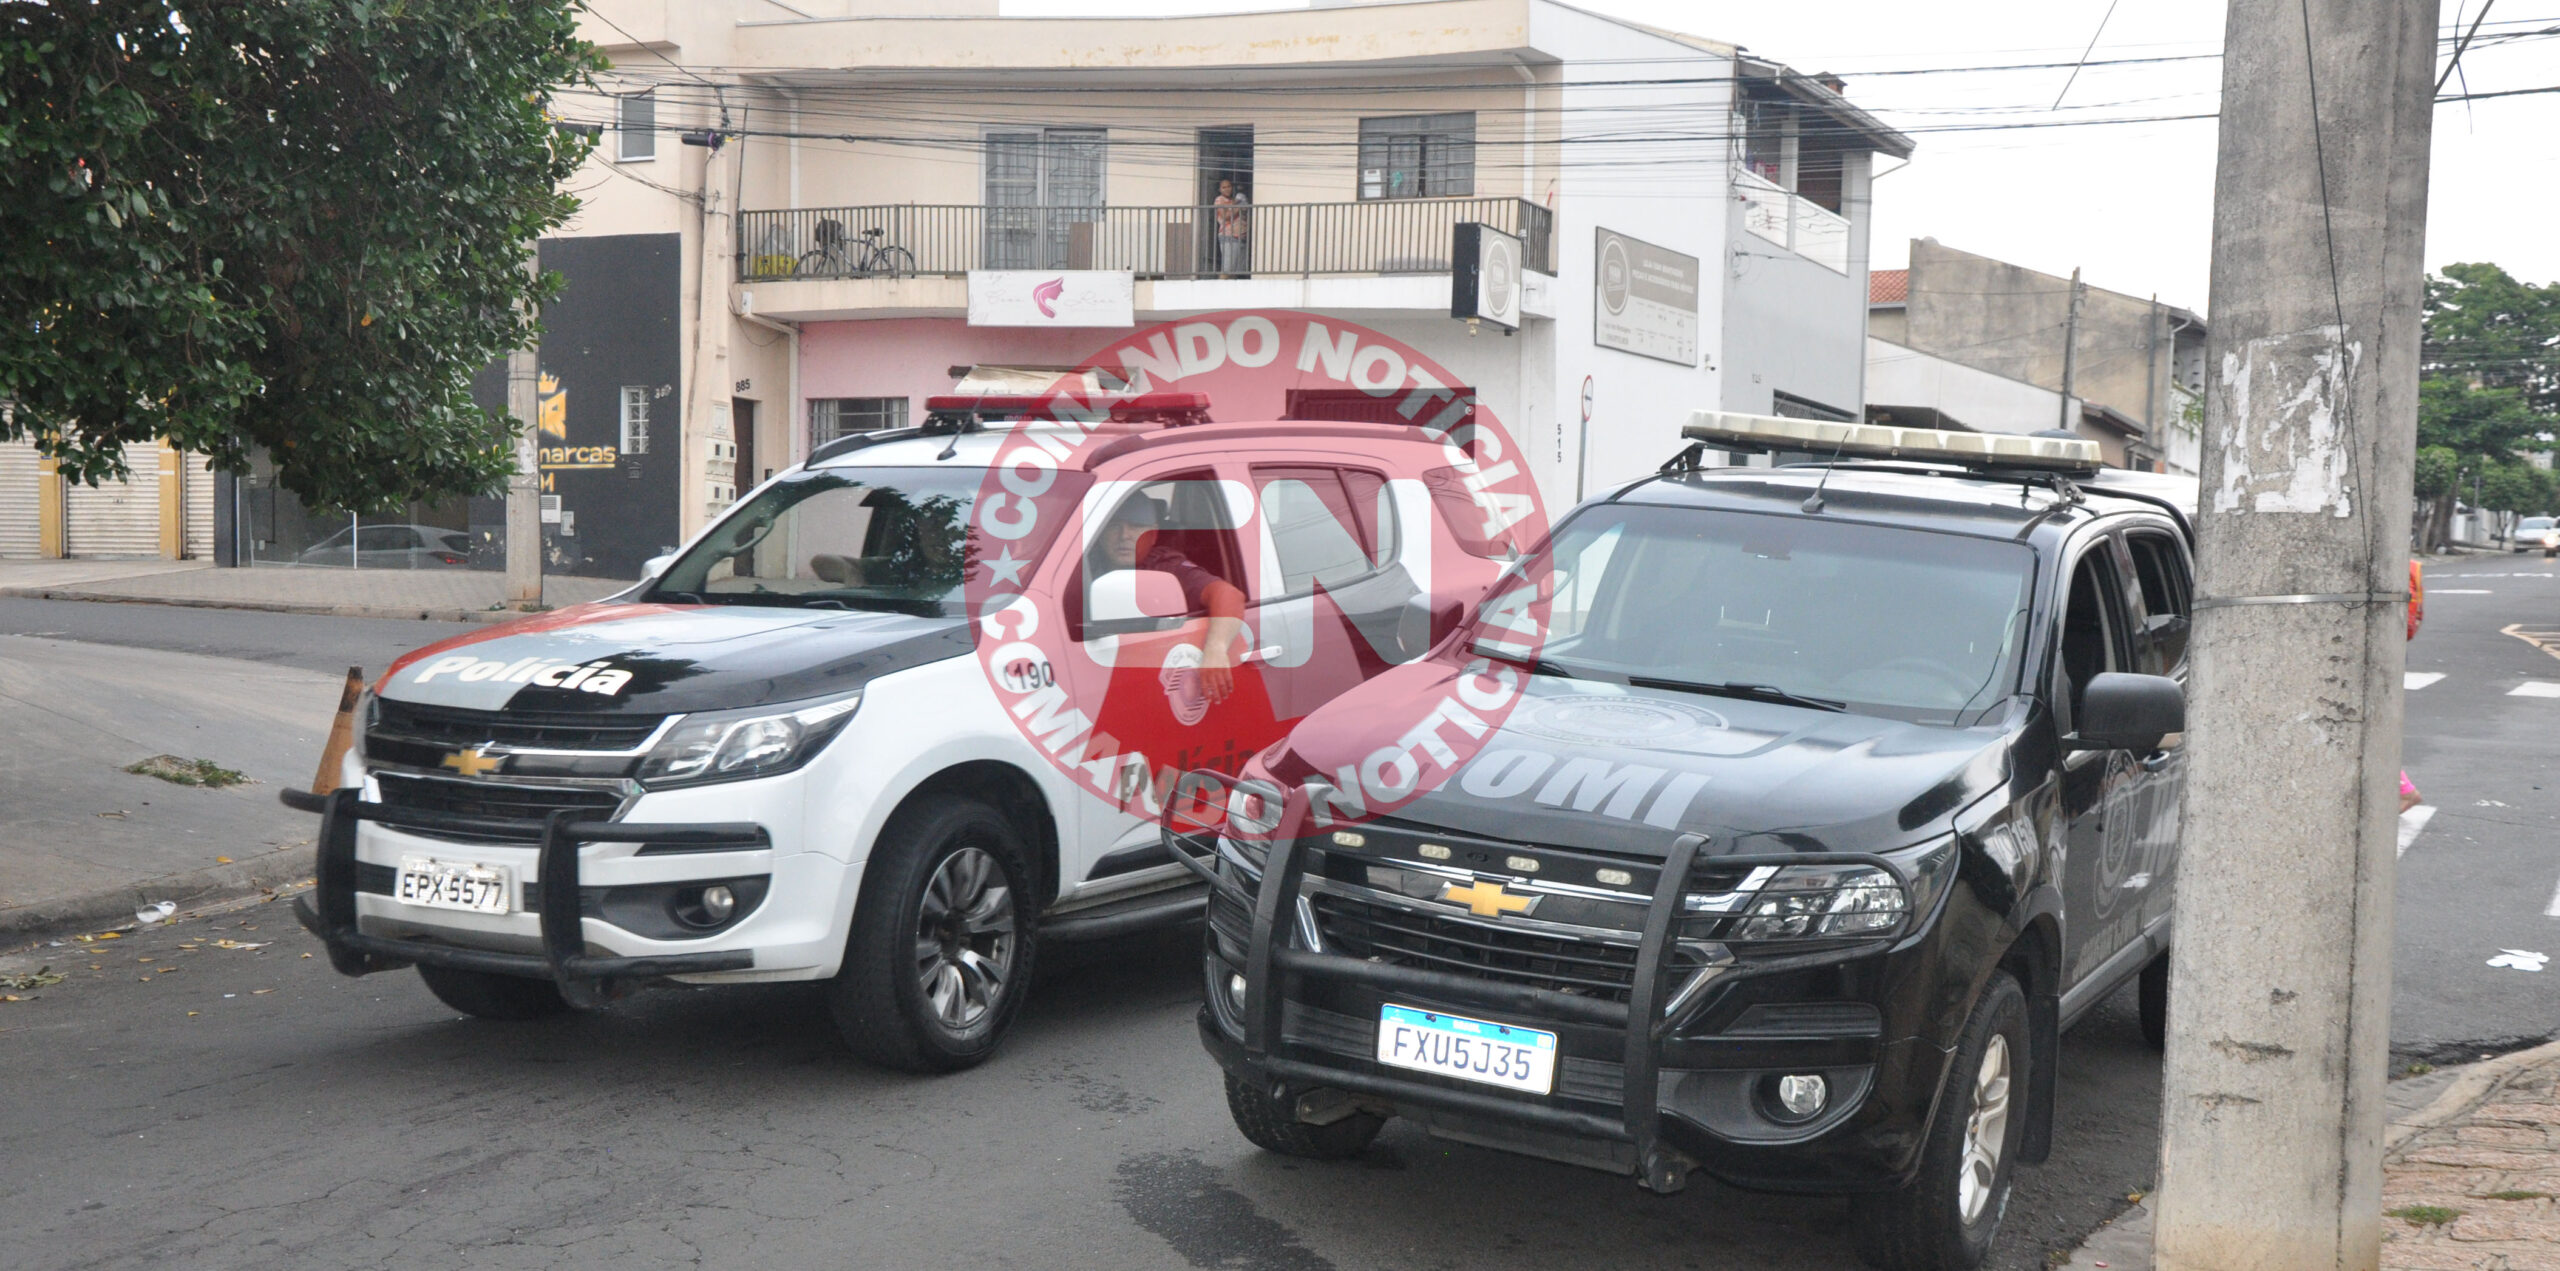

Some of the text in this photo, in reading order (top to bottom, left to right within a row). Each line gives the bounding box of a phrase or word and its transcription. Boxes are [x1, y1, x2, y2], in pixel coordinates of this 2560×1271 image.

[736, 379, 750, 392] 885
[413, 656, 634, 696] Polícia
[1013, 661, 1056, 690] 190
[1394, 1027, 1532, 1081] FXU5J35
